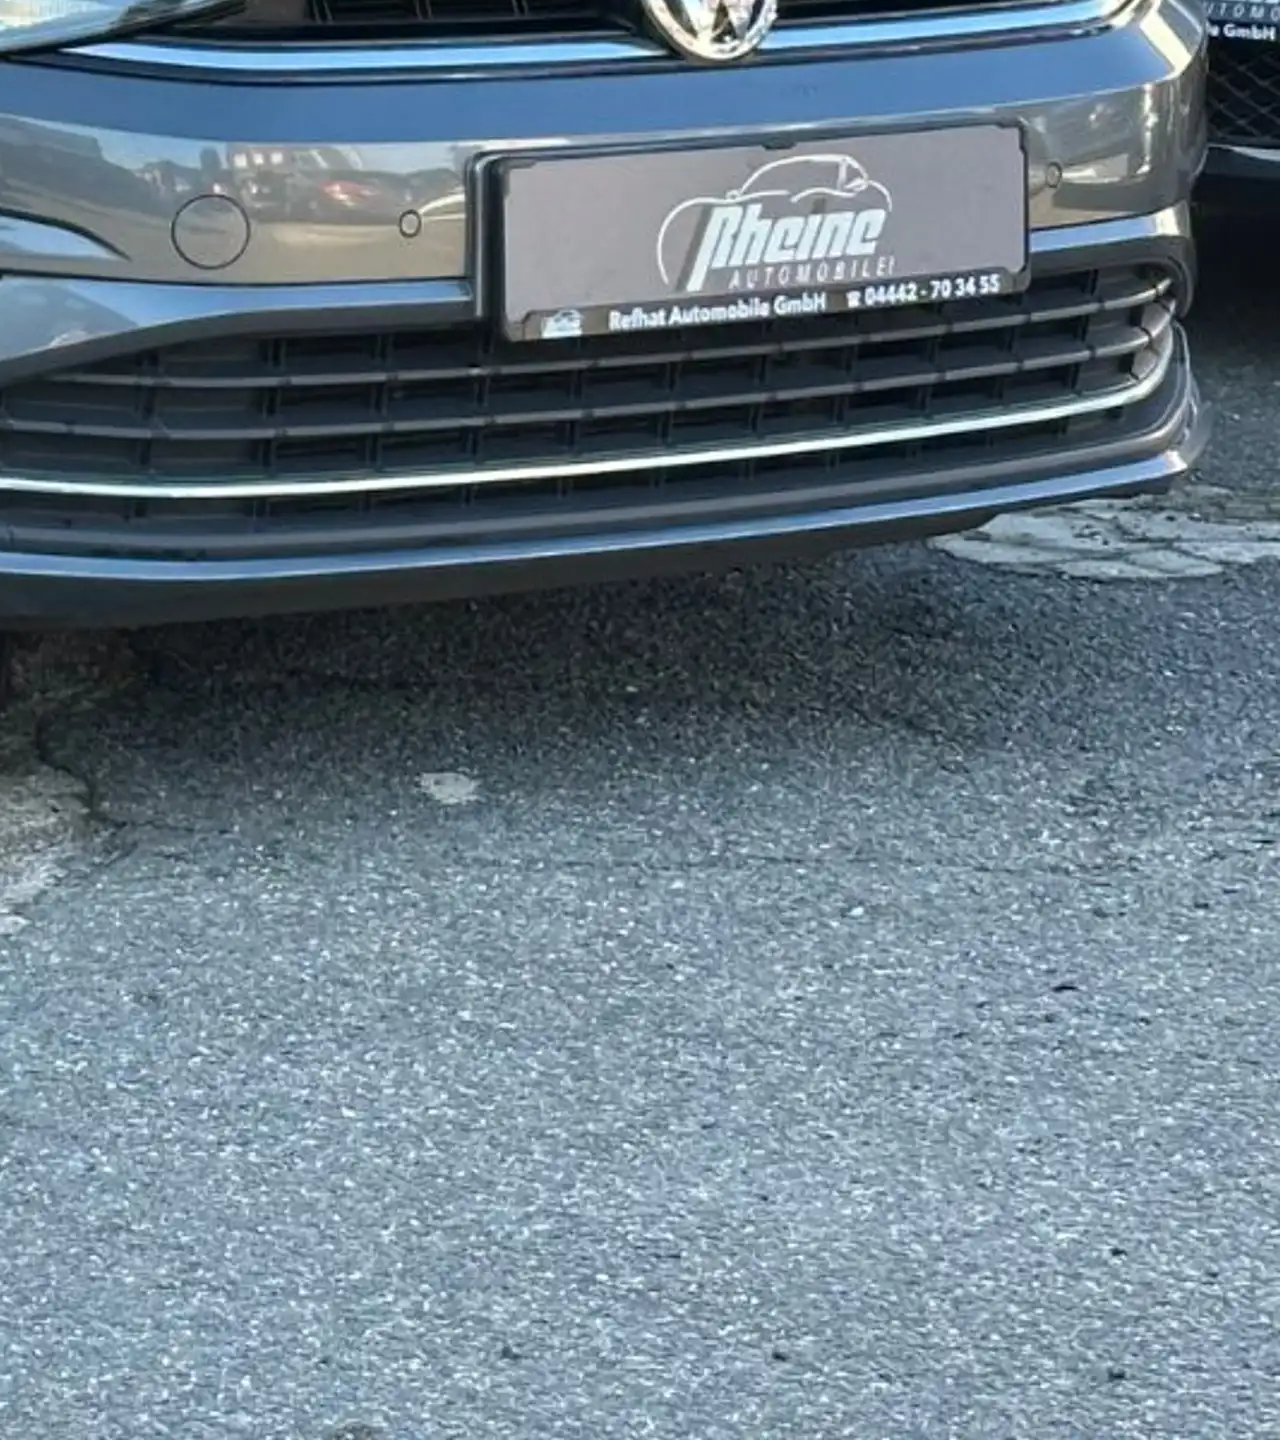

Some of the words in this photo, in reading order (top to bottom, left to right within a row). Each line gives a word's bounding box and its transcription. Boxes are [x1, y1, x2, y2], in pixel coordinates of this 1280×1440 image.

[608, 307, 667, 331] Refhat
[668, 296, 770, 325] Automobile
[773, 291, 827, 316] GmbH
[864, 280, 918, 307] 04442
[931, 279, 950, 300] 70
